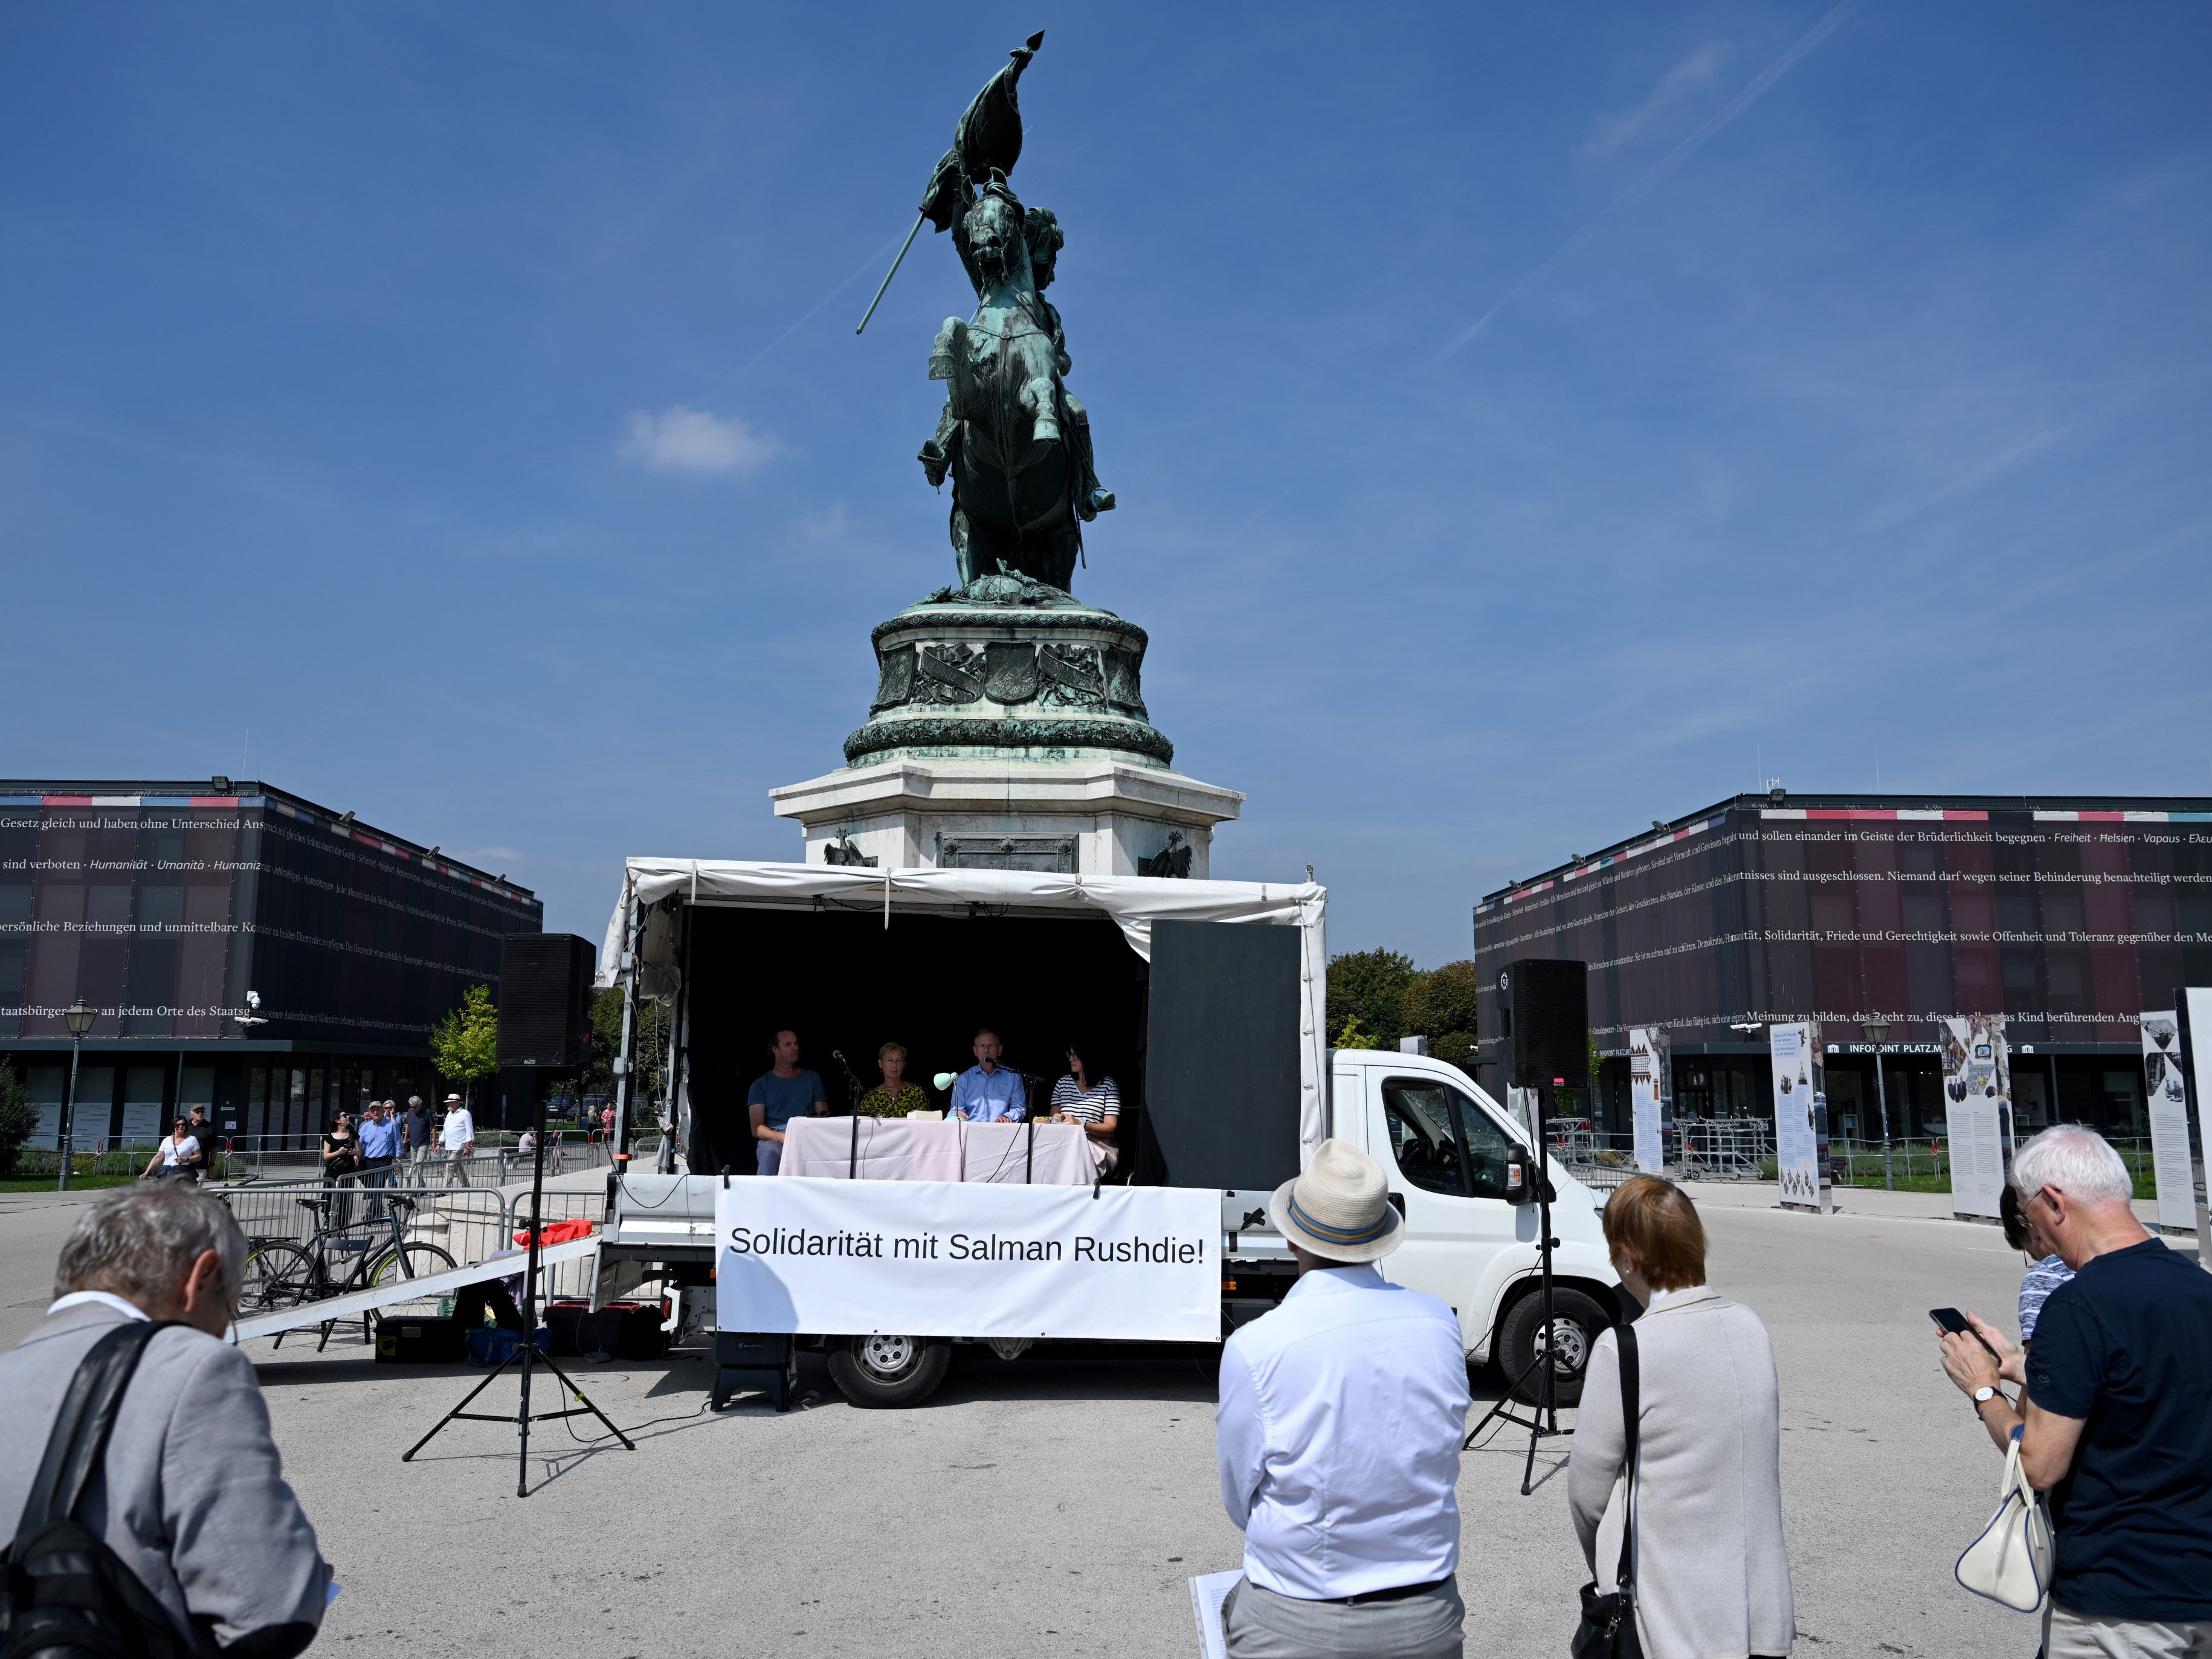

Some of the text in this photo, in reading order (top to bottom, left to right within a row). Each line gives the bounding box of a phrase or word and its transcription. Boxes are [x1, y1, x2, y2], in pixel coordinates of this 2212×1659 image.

[1, 818, 39, 829] Gesetz
[42, 818, 75, 831] gleich
[79, 818, 100, 828] und
[104, 818, 137, 829] haben
[140, 819, 168, 828] ohne
[172, 819, 239, 830] Unterschied
[286, 829, 306, 843] gleichen
[306, 836, 321, 848] Schutz
[321, 841, 334, 853] durch
[343, 849, 356, 860] Gesetz
[1635, 865, 1651, 876] geboren.
[1674, 848, 1691, 860] Vernunft
[1692, 844, 1700, 855] und
[1701, 840, 1721, 851] Gewissen
[1721, 832, 1737, 845] begabt
[1739, 831, 1759, 840] und
[1762, 831, 1792, 841] sollen
[1795, 831, 1841, 840] einander
[1845, 831, 1857, 842] im
[1861, 831, 1894, 841] Geiste
[1897, 831, 1914, 841] der
[1918, 832, 1993, 842] Brüderlichkeit
[1996, 833, 2045, 845] begegnen
[2055, 833, 2091, 842] Freiheit
[2144, 834, 2179, 845] Vapaus
[3, 859, 26, 869] sind
[30, 859, 80, 869] verboten
[90, 860, 148, 869] Humanität
[158, 860, 204, 869] Umanità
[347, 887, 363, 898] Mensch
[1635, 897, 1659, 909] Geschlechtes,
[1666, 889, 1683, 900] Standes,
[1705, 878, 1714, 889] und
[1723, 870, 1775, 883] Bekenntnisses
[1778, 871, 1800, 880] sind
[1803, 871, 1884, 883] ausgeschlossen.
[1888, 871, 1936, 880] Niemand
[1940, 871, 1961, 880] darf
[1963, 875, 1996, 883] wegen
[1999, 872, 2030, 881] seiner
[2034, 872, 2101, 884] Behinderung
[2104, 872, 2170, 884] benachteiligt
[0, 921, 59, 934] ersönliche
[63, 921, 136, 934] Beziehungen
[140, 921, 161, 932] und
[166, 922, 237, 934] unmittelbare
[279, 928, 295, 939] beiden
[296, 932, 322, 945] Elternteilen
[1593, 960, 1610, 970] Menschen
[1651, 949, 1663, 958] achten
[1663, 945, 1672, 955] und
[1677, 943, 1696, 952] schützen.
[1697, 935, 1724, 949] Demokratie,
[1725, 930, 1762, 942] Humanität,
[1765, 930, 1823, 942] Solidarität,
[1826, 930, 1860, 940] Friede
[1863, 930, 1883, 940] und
[1886, 931, 1957, 943] Gerechtigkeit
[1961, 932, 1989, 941] sowie
[1993, 931, 2043, 941] Offenheit
[2046, 932, 2066, 941] und
[2069, 932, 2114, 941] Toleranz
[2118, 932, 2171, 944] gegenüber
[2174, 932, 2193, 941] den
[0, 1003, 67, 1016] taatsbürger
[118, 1003, 153, 1018] jedem
[157, 1006, 183, 1016] Orte
[187, 1006, 205, 1016] des
[267, 1009, 283, 1019] seinen
[284, 1011, 308, 1021] Aufenthalt
[309, 1013, 318, 1022] und
[318, 1014, 338, 1023] Wohnsitz
[1673, 1018, 1685, 1028] Kind,
[1693, 1017, 1704, 1027] fähig
[1711, 1014, 1720, 1023] sich
[1721, 1014, 1732, 1023] eine
[1732, 1013, 1746, 1023] eigene
[1747, 1011, 1794, 1023] Meinung
[1813, 1011, 1849, 1023] bilden,
[1852, 1011, 1870, 1021] das
[1926, 1012, 1953, 1021] diese
[2018, 1012, 2045, 1022] Kind
[2047, 1010, 2114, 1022] berührenden
[730, 1228, 1202, 1263] Solidarität mit Salman Rushdie!
